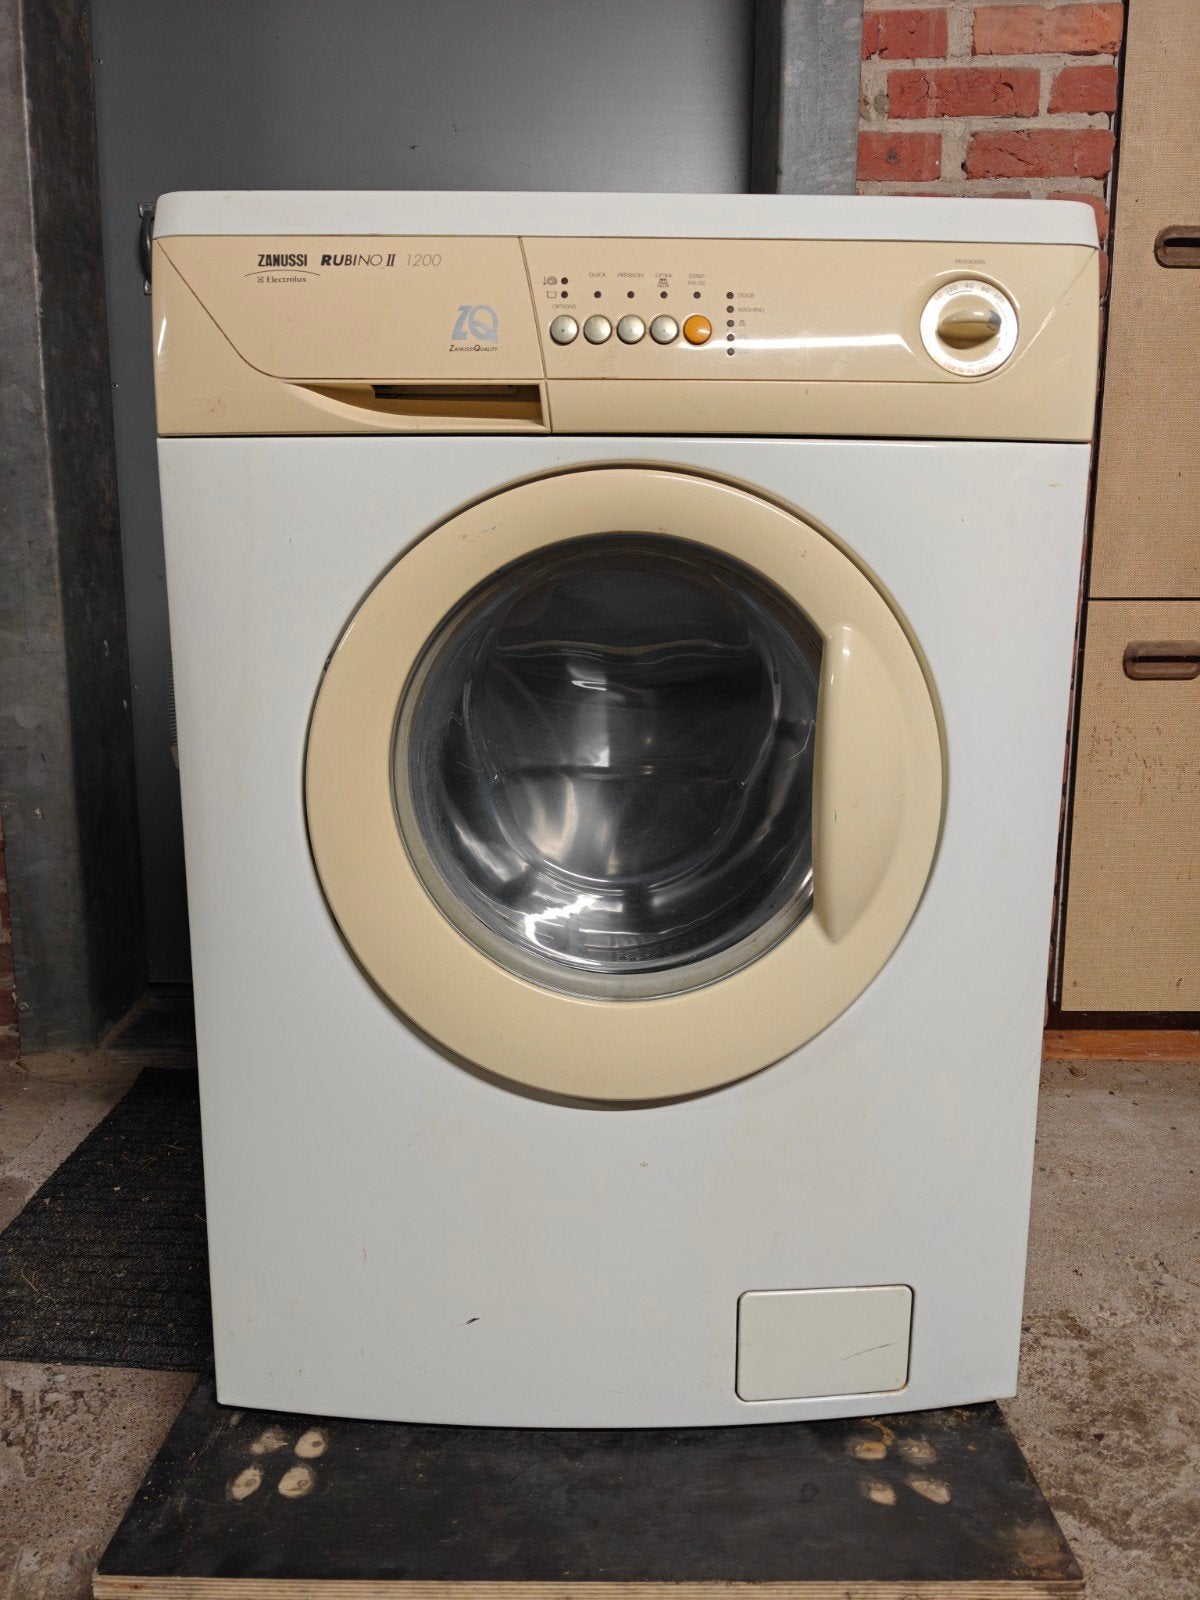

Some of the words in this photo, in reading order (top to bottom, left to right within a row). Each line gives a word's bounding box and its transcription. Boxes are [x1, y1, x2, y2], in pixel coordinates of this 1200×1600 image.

[257, 254, 307, 266] ZANUSSI
[320, 254, 383, 266] RUBINO
[386, 254, 396, 267] II
[406, 254, 442, 266] 1200
[266, 275, 307, 284] Electrolux
